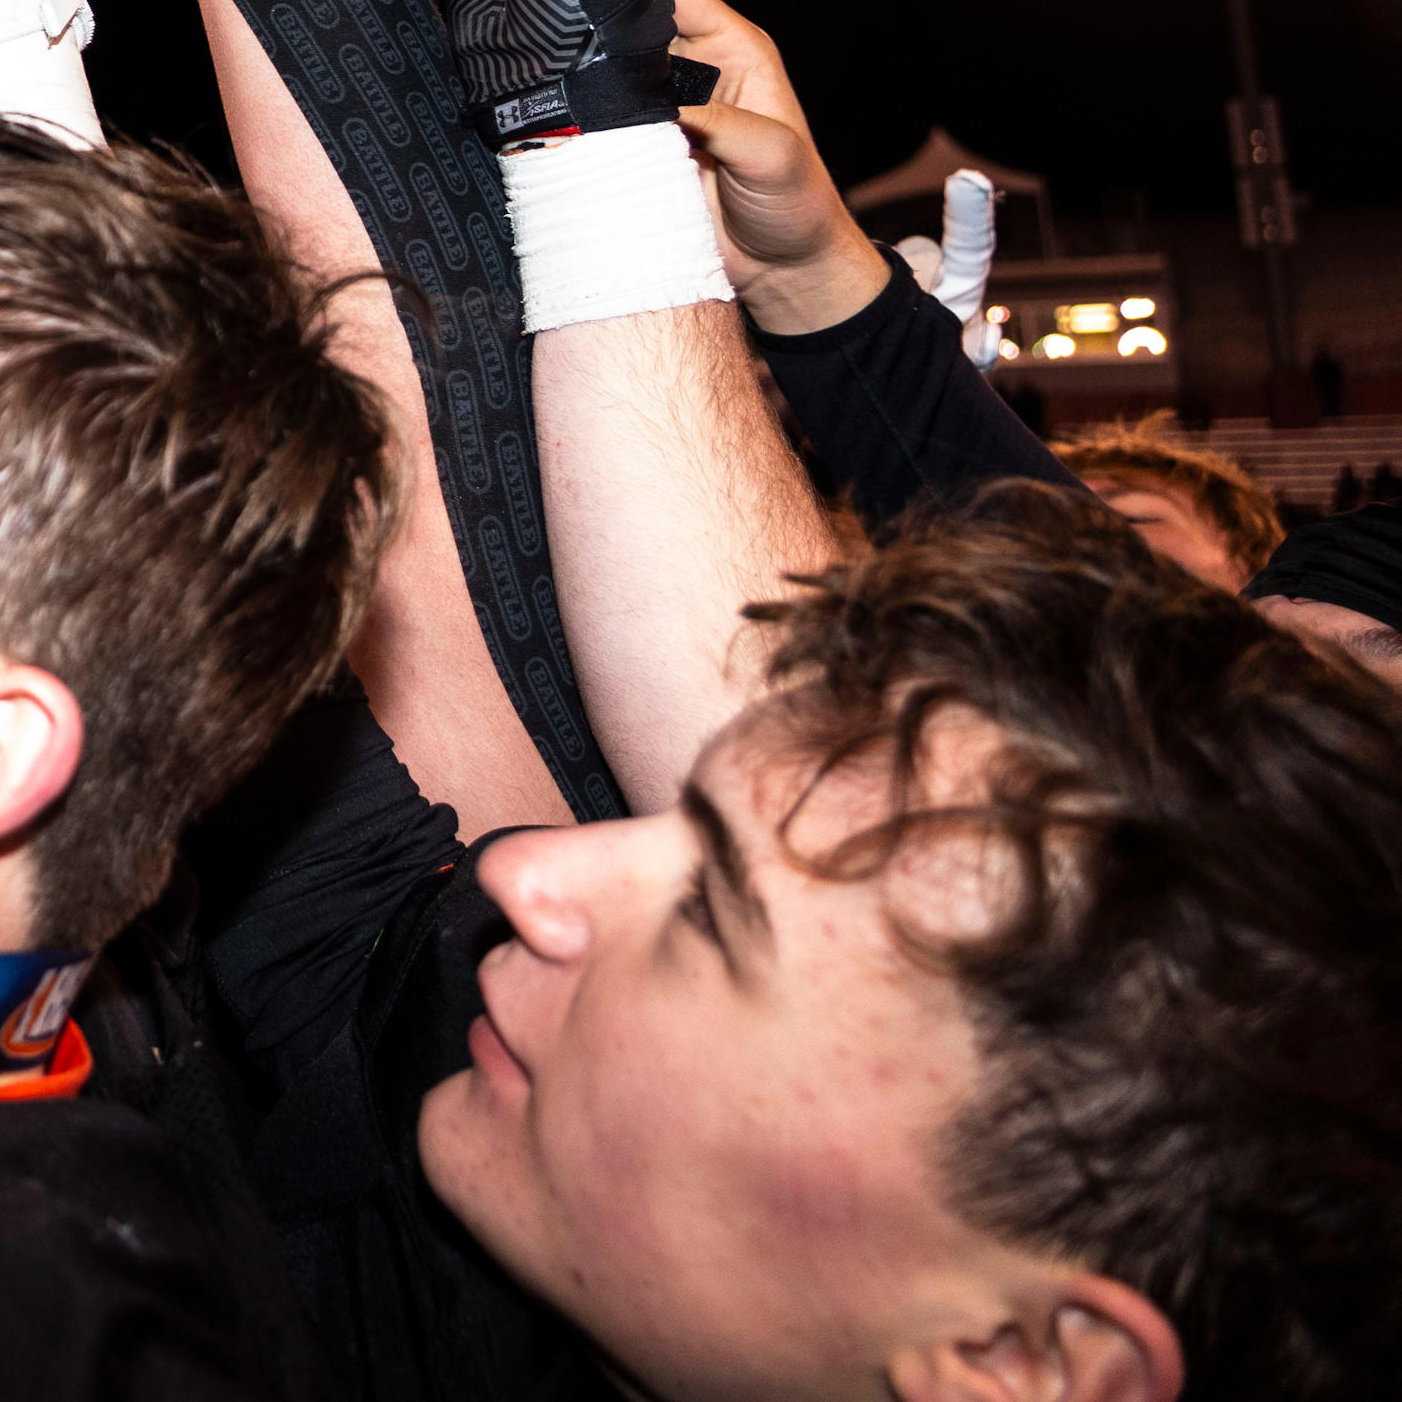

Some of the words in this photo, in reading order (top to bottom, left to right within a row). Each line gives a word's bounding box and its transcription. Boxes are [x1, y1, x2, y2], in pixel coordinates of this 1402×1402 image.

[276, 13, 340, 96] BATTLE
[345, 53, 406, 139] BATTLE
[348, 127, 407, 213] BATTLE
[410, 99, 464, 187] BATTLE
[414, 172, 464, 262] BATTLE
[467, 297, 506, 398] BATTLE
[451, 381, 486, 483] BATTLE
[501, 442, 537, 546] BATTLE
[482, 528, 528, 631] BATTLE
[530, 665, 580, 754] BATTLE
